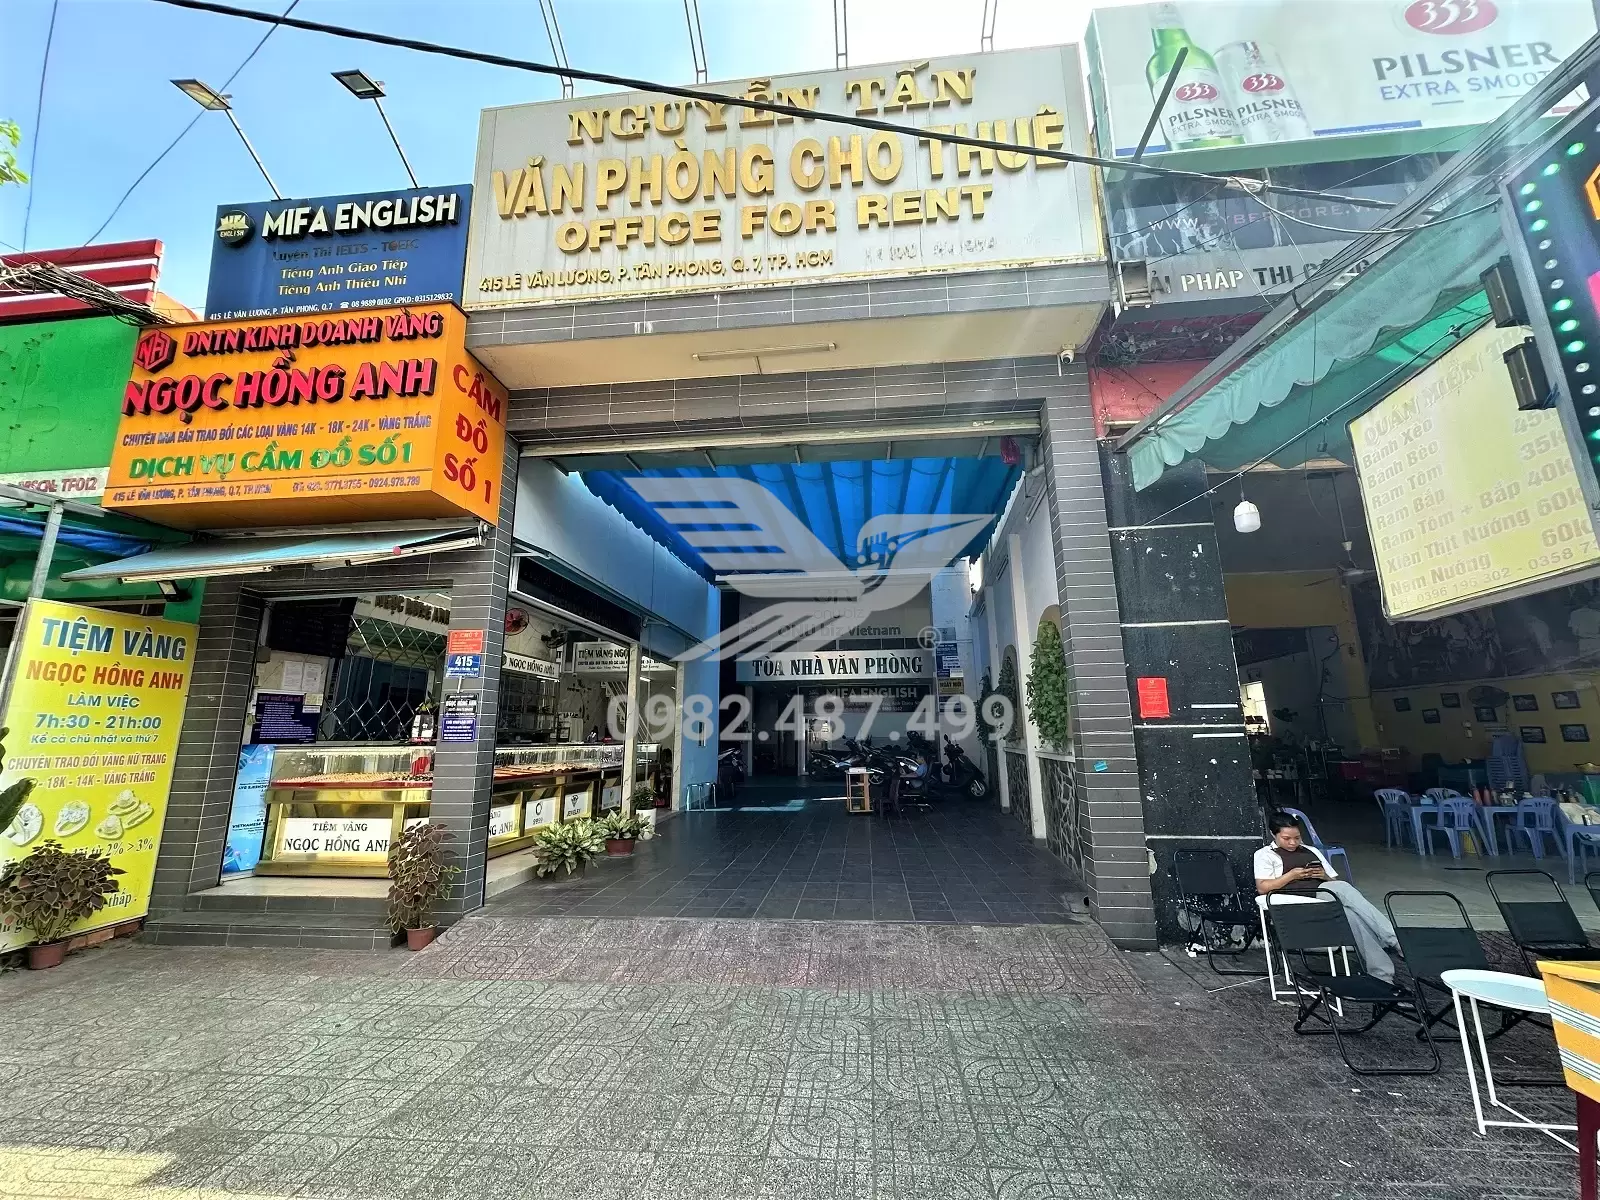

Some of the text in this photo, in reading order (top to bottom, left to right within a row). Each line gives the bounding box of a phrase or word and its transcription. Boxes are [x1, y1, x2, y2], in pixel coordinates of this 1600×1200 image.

[1372, 41, 1564, 80] PILSNER
[1182, 82, 1210, 100] 333
[1250, 72, 1278, 90] 333
[1379, 79, 1460, 101] EXTRA
[566, 60, 976, 146] NGUYỄN TẤN
[1237, 99, 1302, 118] PILSNER
[1168, 107, 1235, 127] PILSNER
[1241, 113, 1271, 126] EXTRA
[1172, 122, 1201, 135] EXTRA
[492, 104, 1069, 219] VĂN PHÒNG CHO THUÊ
[261, 193, 459, 239] MIFA ENGLISH
[555, 184, 993, 254] OFFICE FOR RENT
[336, 242, 369, 256] IELTS
[381, 238, 419, 253] TOEIC
[317, 263, 344, 275] Anh
[348, 261, 378, 273] Giao
[478, 276, 503, 292] 415
[504, 273, 522, 290] LÊ
[526, 268, 555, 289] VĂN
[617, 267, 631, 282] P.
[632, 261, 663, 281] TÂN
[667, 259, 727, 278] PHONG,
[731, 257, 749, 273] Q.
[767, 255, 792, 270] TP.
[796, 250, 833, 267] HCM
[1252, 264, 1294, 288] THI
[314, 280, 341, 292] Anh
[384, 274, 407, 287] Nhi
[209, 312, 222, 321] 415
[351, 300, 360, 308] 08
[184, 307, 442, 354] DNTN KINH DOANH VÀNG
[122, 349, 436, 423] NGỌC HỒNG ANH
[122, 430, 157, 447] CHUYÊN
[195, 428, 218, 441] TRAO
[236, 424, 253, 439] CÁC
[255, 424, 274, 440] LOẠI
[276, 421, 298, 436] VÀNG
[300, 422, 317, 436] 14K
[327, 420, 345, 434] 18K
[351, 418, 370, 432] 24K
[378, 415, 401, 431] VÀNG
[455, 412, 488, 455] ĐỒ
[129, 454, 195, 484] DỊCH
[199, 453, 236, 481] VỤ
[358, 433, 401, 466] SỐ
[402, 441, 414, 463] 1
[1361, 438, 1400, 470] Bánh
[443, 452, 492, 504] SỐ 1
[1366, 460, 1404, 490] Bánh
[112, 492, 126, 502] 415
[1371, 463, 1444, 510] Ram Tôm
[1375, 505, 1410, 531] Ram
[1380, 527, 1415, 552] Ram
[1417, 510, 1456, 536] Tôm
[1424, 535, 1459, 559] Thịt
[1461, 507, 1531, 545] Nướng
[1416, 547, 1575, 603] 0396 302 0358
[41, 616, 187, 661] TIỆM VÀNG
[848, 624, 901, 637] vietnam
[454, 655, 474, 667] 415
[752, 655, 785, 677] TÒA
[789, 654, 825, 676] NHÀ
[827, 653, 860, 675] VĂN
[864, 652, 923, 675] PHÒNG
[26, 659, 184, 690] NGỌC HỒNG ANH
[67, 691, 140, 711] LÀM VIỆC
[860, 686, 917, 699] ENGLISH
[35, 713, 162, 729] 7h:30 21h:00
[51, 732, 67, 744] cả
[69, 732, 91, 743] chủ
[93, 733, 118, 744] nhật
[119, 733, 133, 743] và
[153, 734, 159, 742] 7
[8, 753, 50, 770] CHUYÊN
[55, 754, 80, 769] TRAO
[102, 751, 125, 767] VÀNG
[141, 752, 168, 765] TRANG
[47, 768, 156, 789] 18K 14K VÀNG TRẮNG
[312, 820, 369, 833] TIỆM VÀNG
[104, 842, 124, 857] 2%
[136, 837, 154, 852] 3%
[283, 836, 320, 854] NGỌC
[324, 833, 361, 852] HỒNG
[108, 888, 132, 908] thấp
